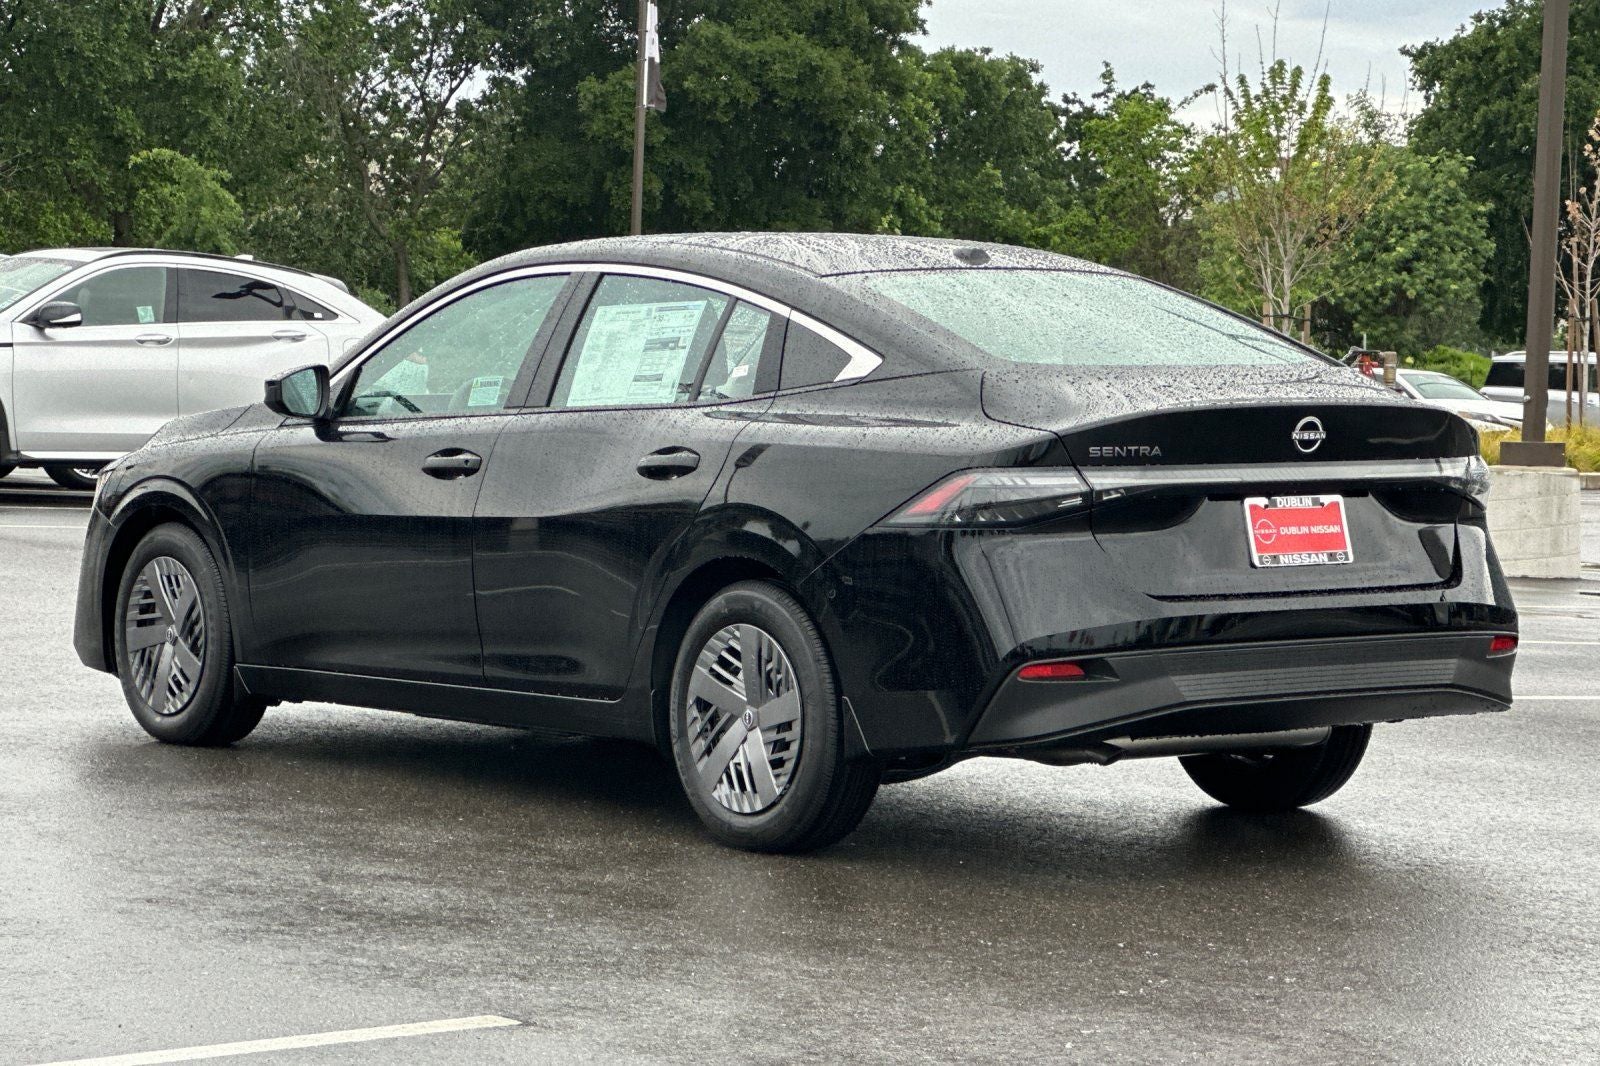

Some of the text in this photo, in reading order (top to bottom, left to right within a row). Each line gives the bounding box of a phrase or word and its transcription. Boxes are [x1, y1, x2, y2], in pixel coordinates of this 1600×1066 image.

[1292, 431, 1326, 440] NISSAN
[1088, 446, 1162, 457] SENTRA
[1276, 497, 1312, 507] DUBLIN
[1280, 525, 1340, 535] DUBLIN NISSAN
[1279, 553, 1328, 564] NISSAN
